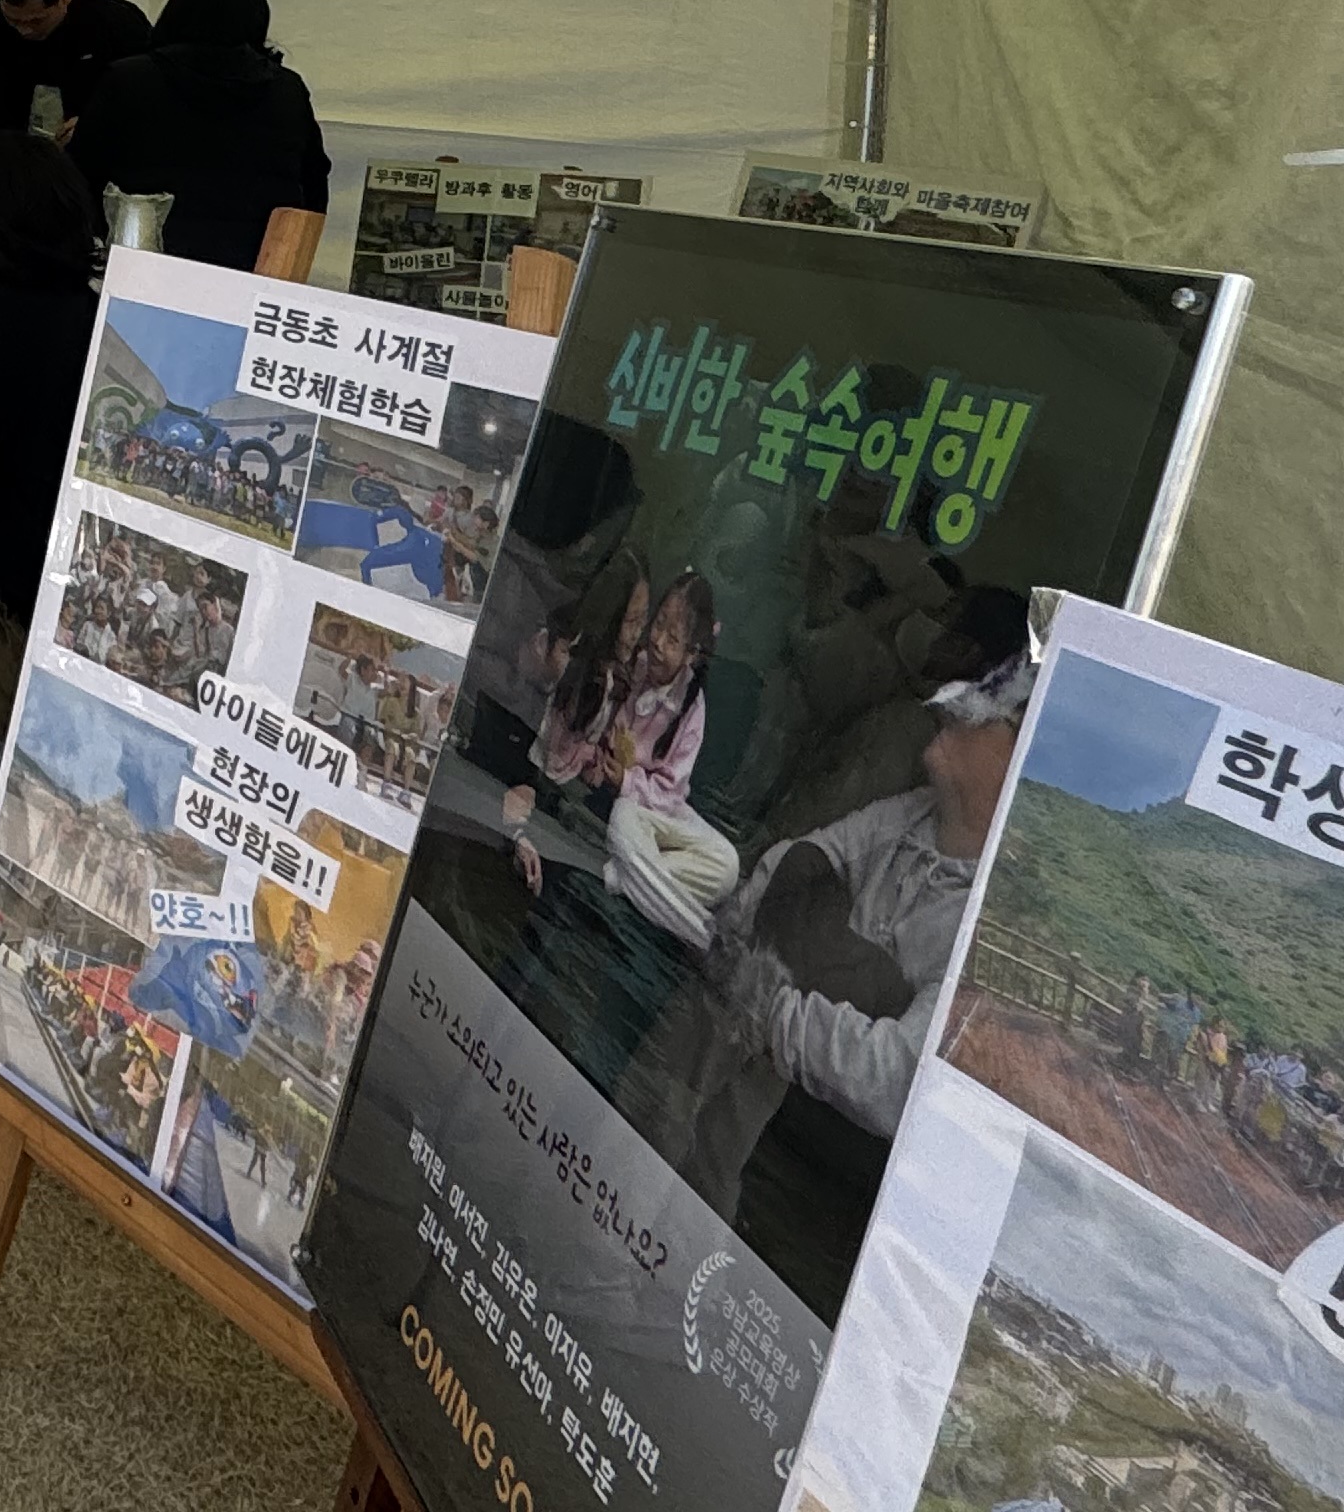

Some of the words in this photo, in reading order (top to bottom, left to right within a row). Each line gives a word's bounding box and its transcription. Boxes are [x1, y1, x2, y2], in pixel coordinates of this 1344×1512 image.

[445, 180, 492, 198] 방과후
[565, 180, 599, 201] 영어
[824, 172, 910, 200] 지역사회와
[916, 190, 1031, 223] 마을축제참여
[252, 300, 339, 352] 금동초
[353, 321, 454, 381] 사계절
[248, 354, 433, 434] 현장체험학습
[606, 320, 743, 456] 신비한
[746, 356, 1044, 550] 숲속여행
[197, 674, 348, 789] 아이들에게
[211, 744, 300, 824] 현장의
[184, 789, 328, 897] 생생함을!!
[150, 891, 253, 937] 얏호~!!
[408, 970, 448, 1025] 누군가
[446, 1014, 502, 1094] 소외되고
[502, 1078, 537, 1141] 있는
[537, 1125, 591, 1205] 사람은
[593, 1180, 669, 1281] 없나요?
[723, 1292, 801, 1391] 경남교육영상
[726, 1329, 780, 1402] 공모대회
[400, 1304, 496, 1469] COMING
[544, 1313, 594, 1406] 이지유,
[601, 1386, 660, 1495] 배지현,
[710, 1347, 736, 1389] 은상
[738, 1382, 779, 1438] 수상작
[559, 1405, 616, 1506] 탁도훈
